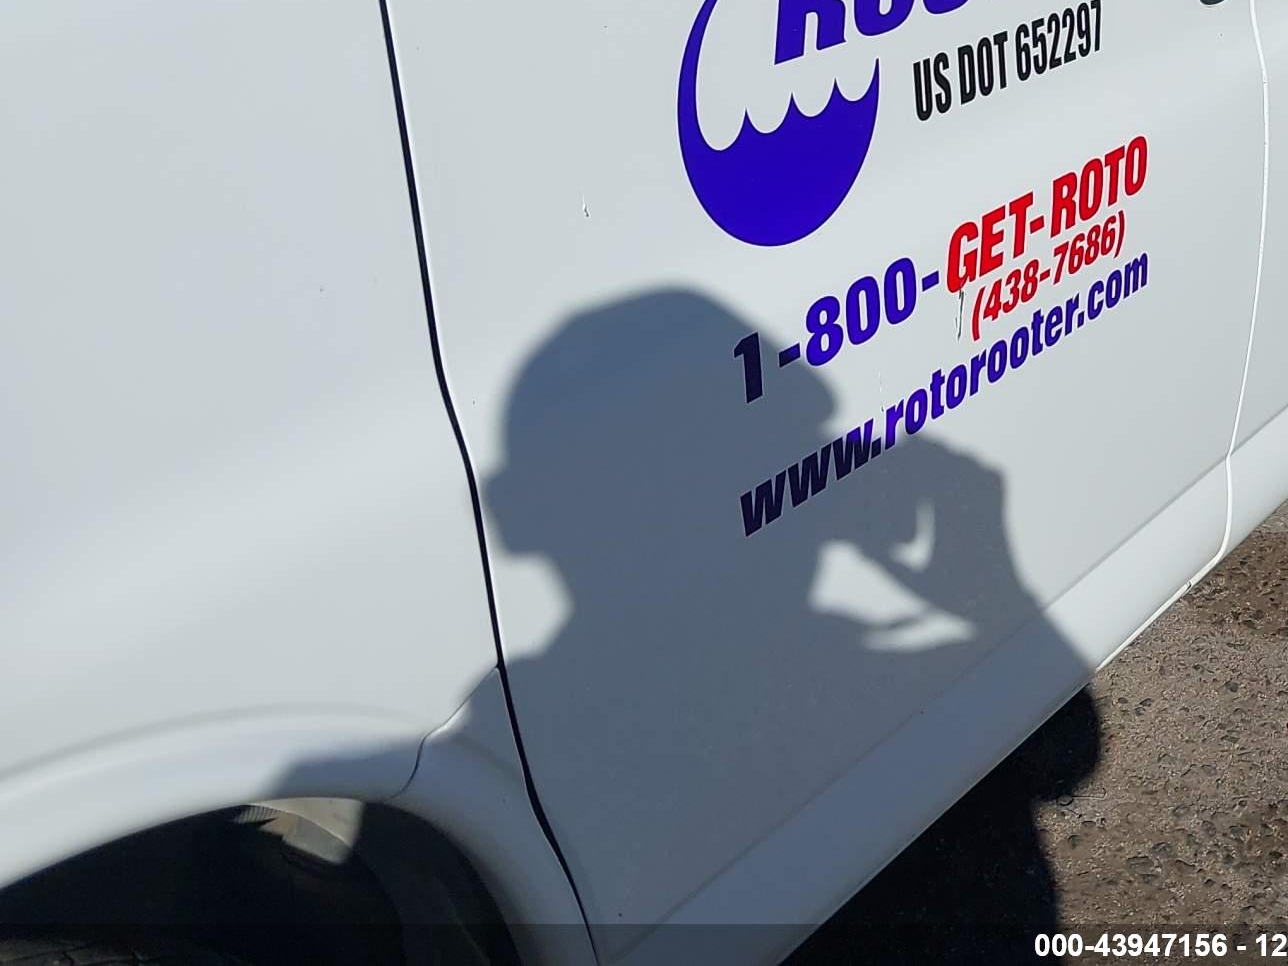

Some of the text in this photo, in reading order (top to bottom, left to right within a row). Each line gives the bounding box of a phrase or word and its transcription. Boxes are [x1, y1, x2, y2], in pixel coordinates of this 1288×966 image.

[912, 51, 952, 122] US
[957, 30, 1008, 105] DOT
[733, 136, 1148, 404] 1-800-GET-ROTO
[971, 210, 1126, 341] (438-7686)
[739, 252, 1149, 538] www.rotorooter.com
